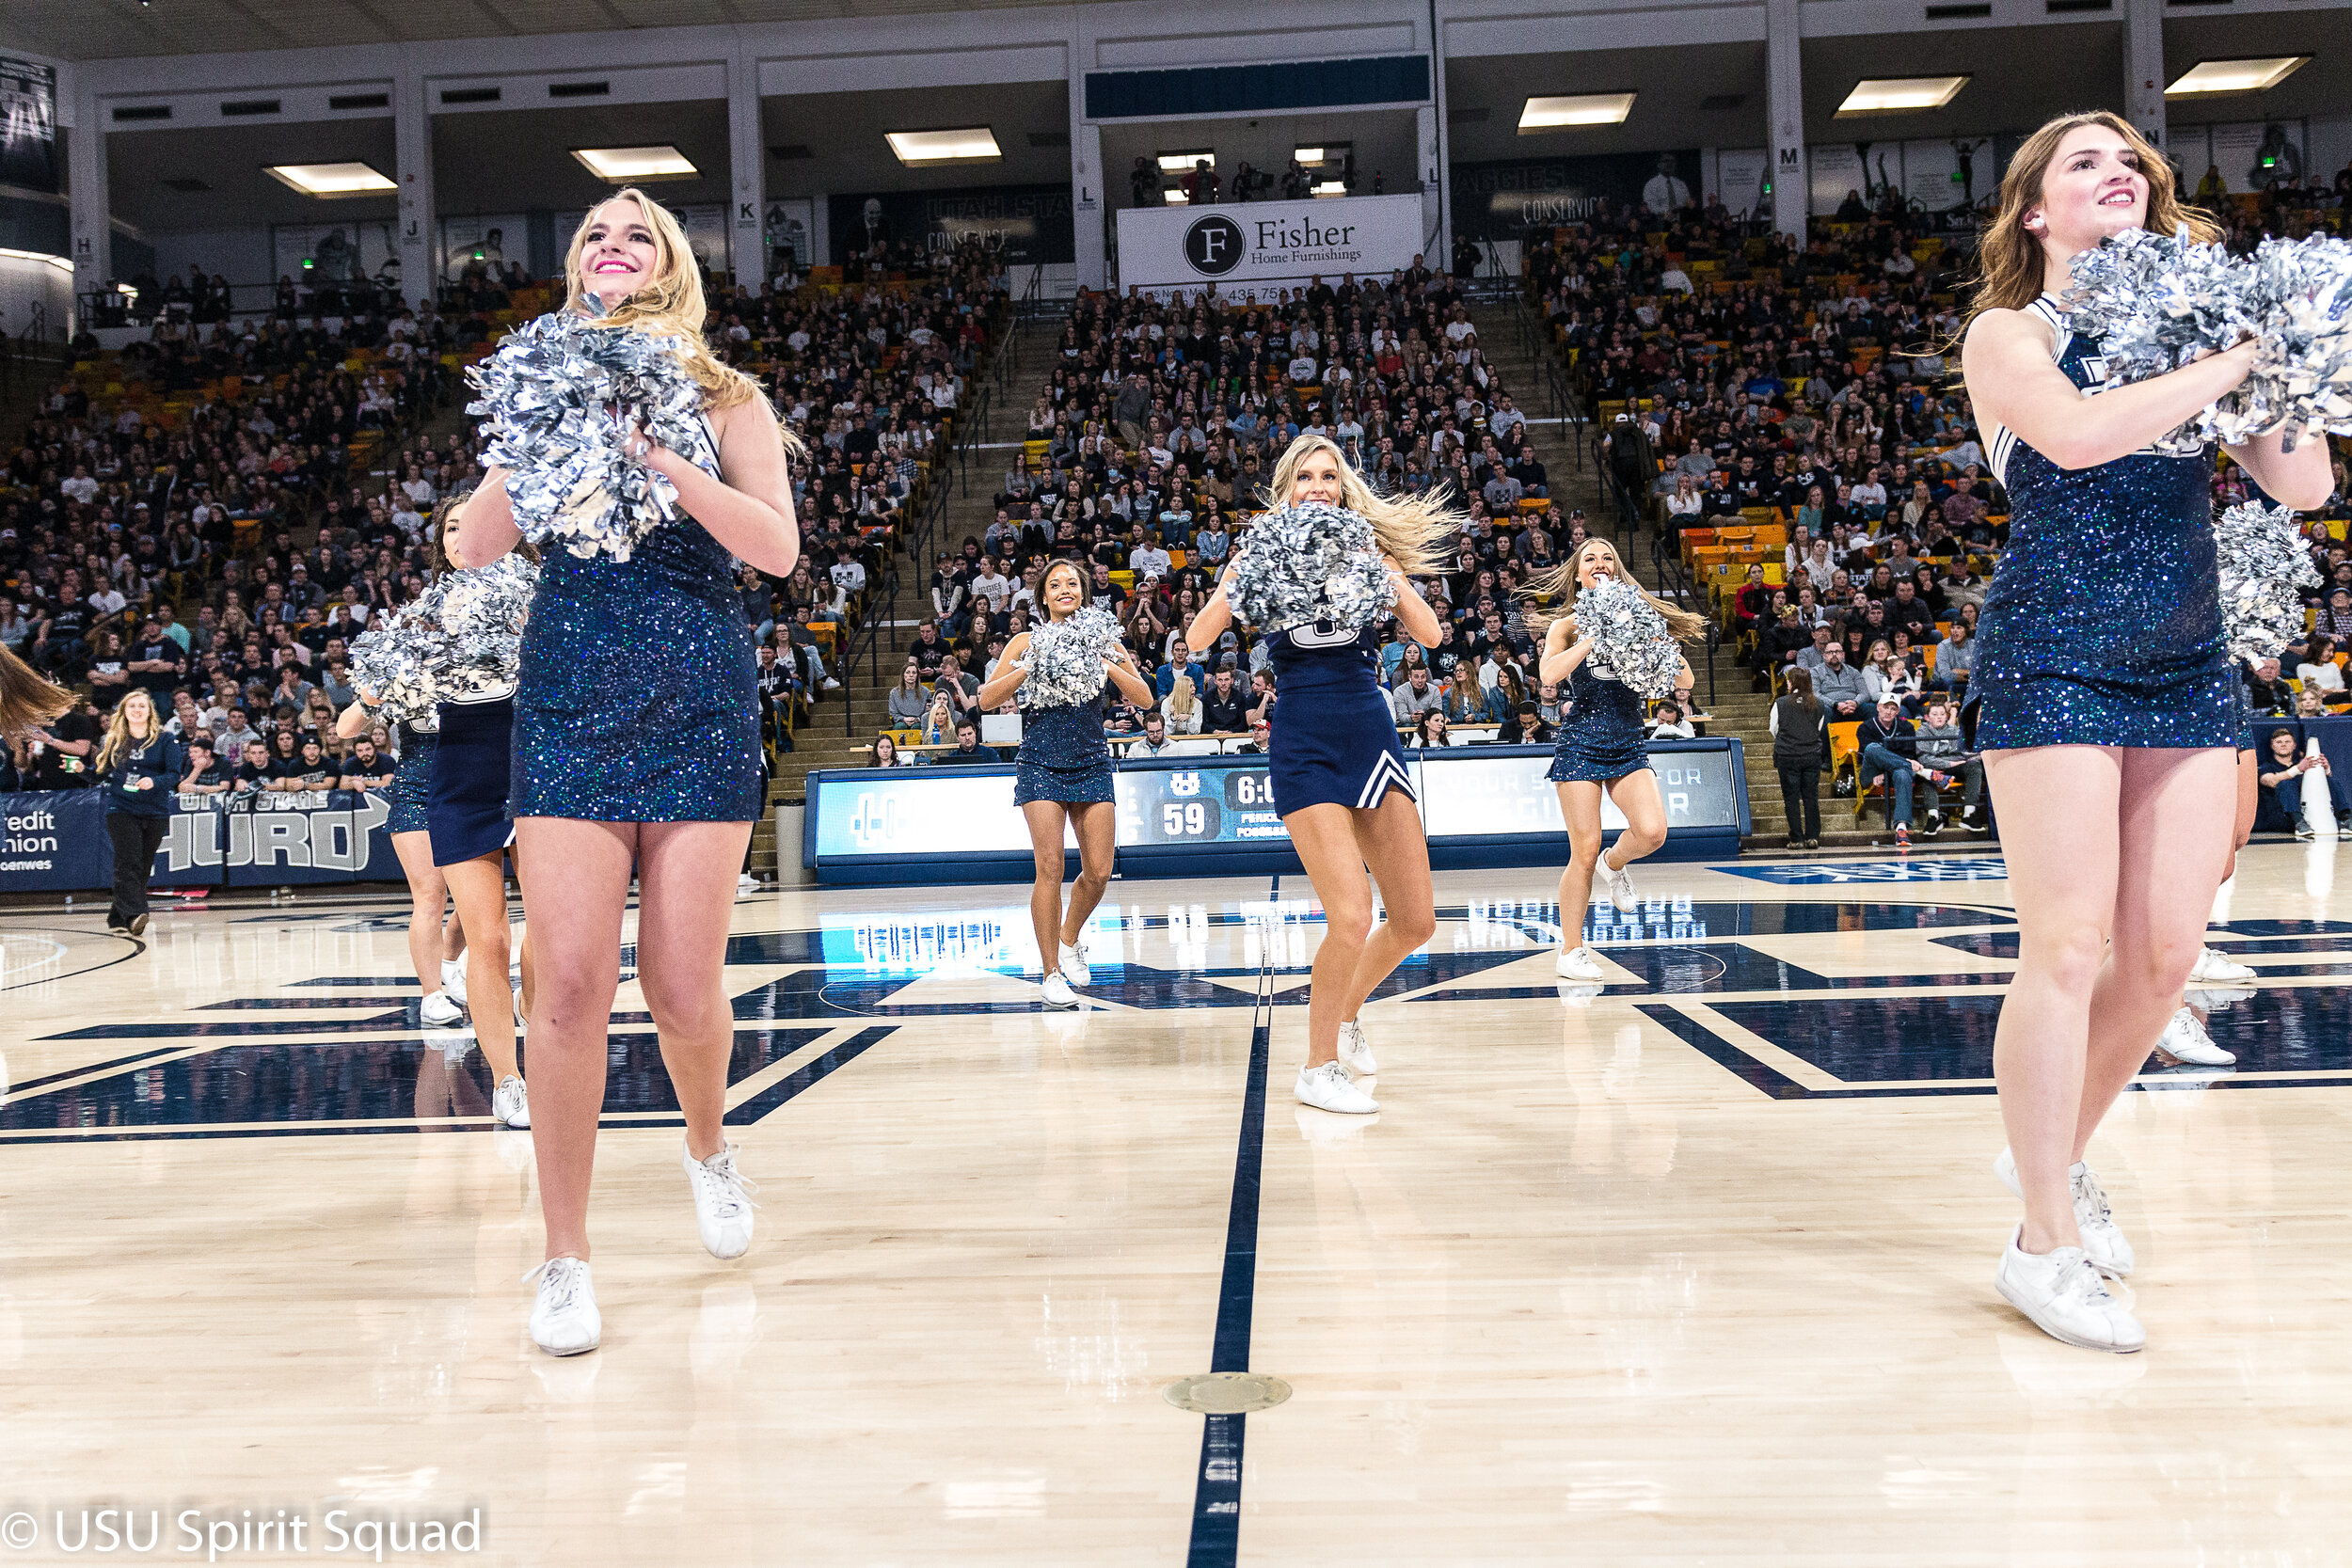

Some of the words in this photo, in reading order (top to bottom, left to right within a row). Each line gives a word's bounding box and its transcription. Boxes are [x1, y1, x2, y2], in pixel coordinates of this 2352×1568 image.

[2145, 130, 2159, 144] N
[1780, 149, 1797, 165] M
[1082, 186, 1094, 202] L
[739, 202, 754, 218] K
[1522, 196, 1609, 225] CONSERVIC
[406, 220, 417, 236] J
[77, 238, 90, 252] H
[1200, 228, 1227, 263] F
[1254, 215, 1356, 250] Fisher
[1251, 251, 1288, 265] Home
[1291, 247, 1362, 263] Furnishings
[255, 790, 329, 811] STATE
[1163, 802, 1205, 835] 59
